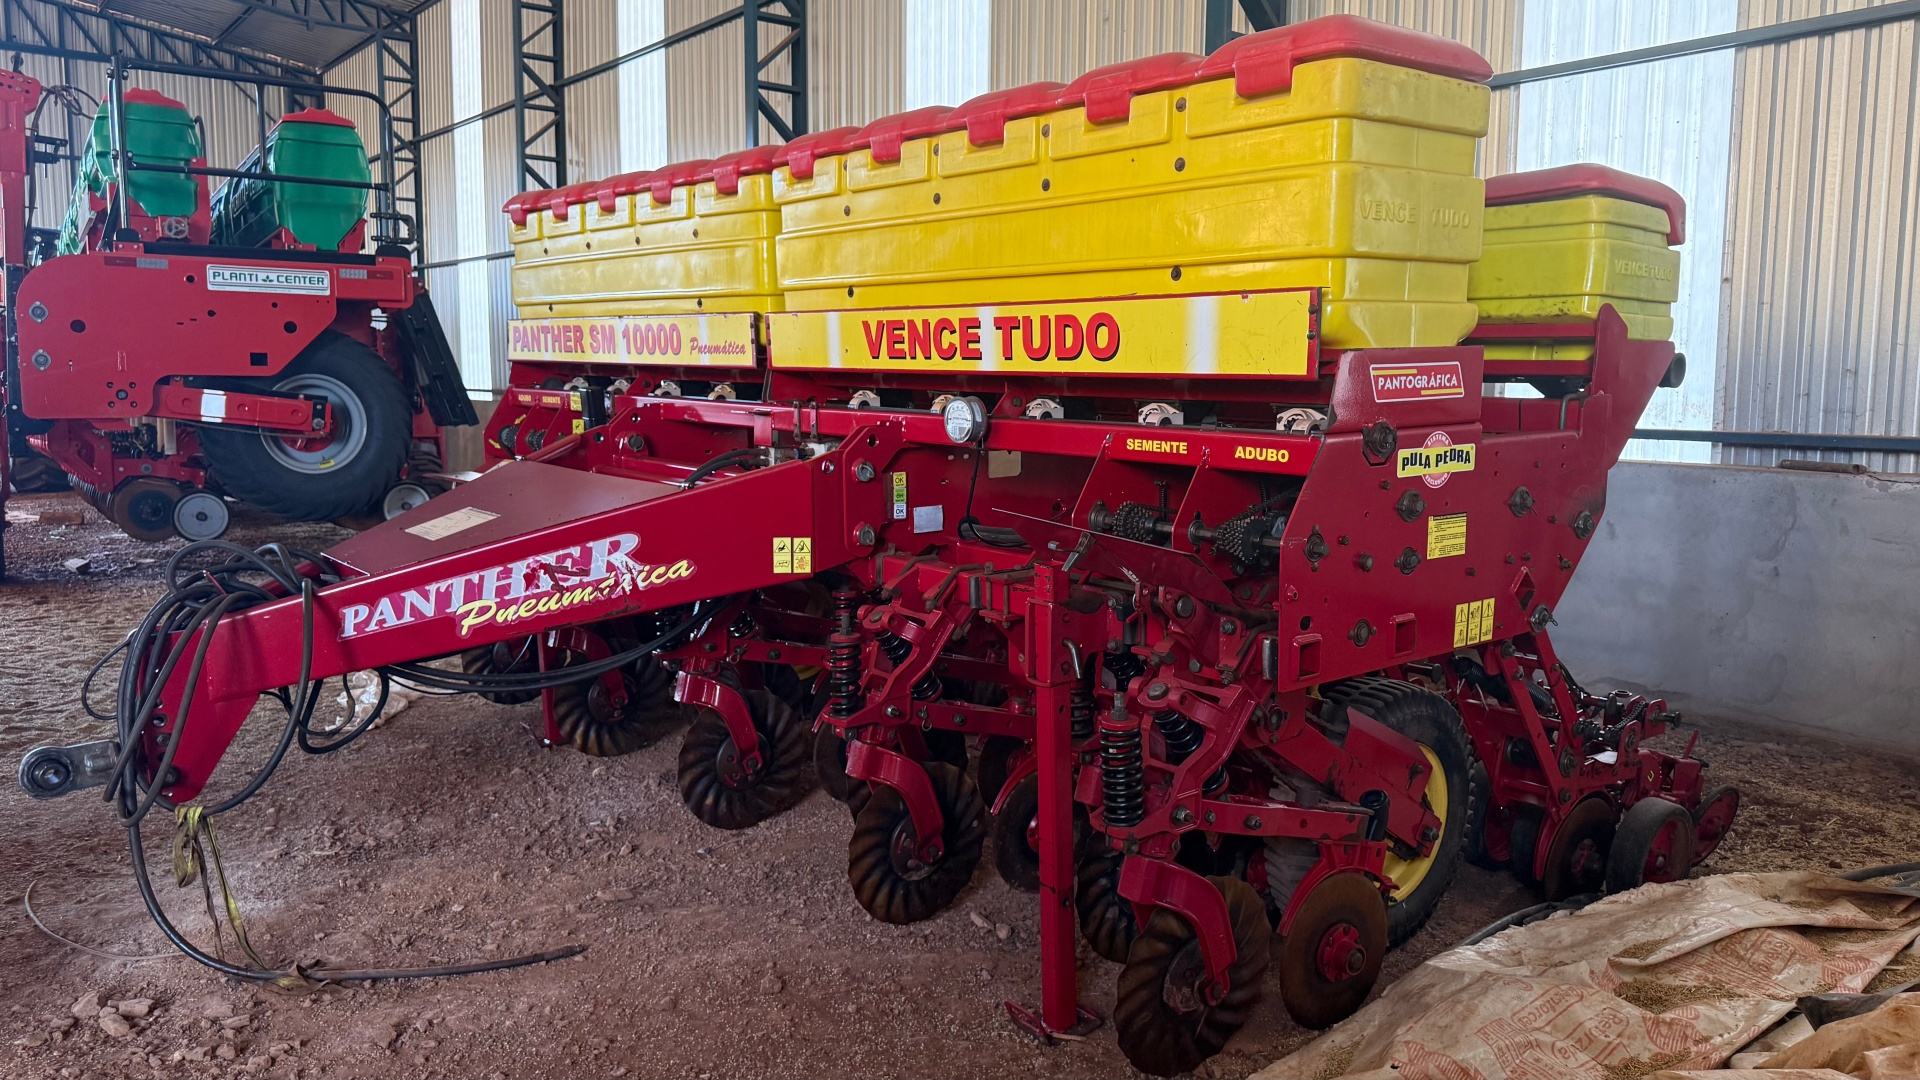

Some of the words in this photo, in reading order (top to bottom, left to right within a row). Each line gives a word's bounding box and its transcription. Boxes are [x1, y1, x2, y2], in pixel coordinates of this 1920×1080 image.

[1360, 199, 1417, 223] VENCE
[1431, 208, 1471, 228] TUDO
[212, 271, 259, 282] PLANTI
[276, 274, 325, 285] CENTER
[1614, 259, 1648, 278] VENCE
[513, 324, 585, 354] PANTHER
[589, 324, 616, 354] SM
[622, 323, 682, 355] 10000
[689, 337, 747, 356] Pneumática
[861, 317, 983, 361] VENCE
[993, 312, 1121, 362] TUDO
[1378, 371, 1458, 390] PANTOGRÁFICA
[518, 394, 532, 402] ADUBO
[542, 396, 561, 404] SEMENTE
[1126, 438, 1188, 454] SEMENTE
[1234, 446, 1289, 463] ADUBO
[1401, 452, 1431, 472] PULA
[1435, 448, 1471, 468] PEDRA
[894, 476, 905, 484] OK
[340, 533, 641, 639] PANTHER
[456, 559, 696, 636] Pneumáica
